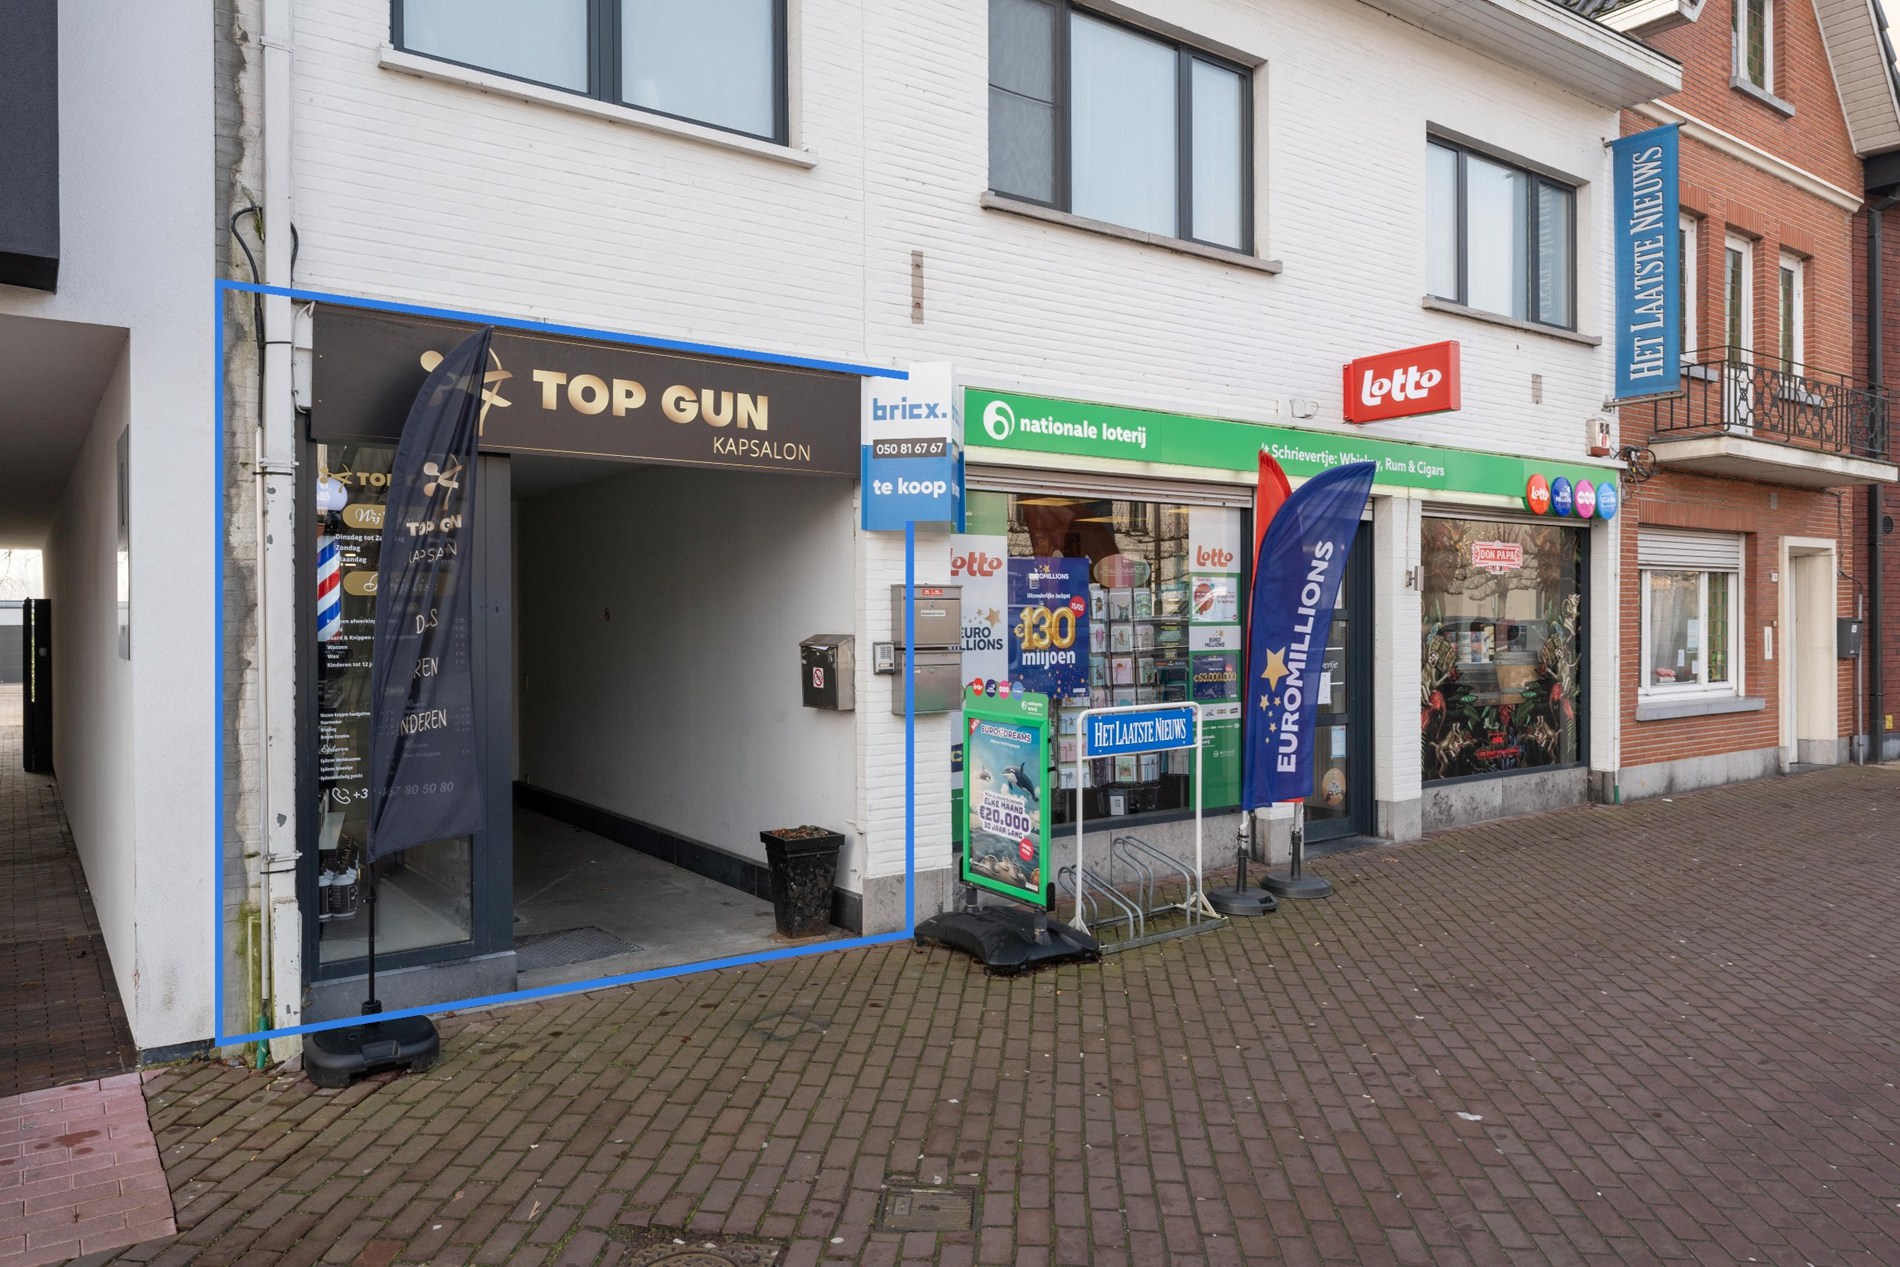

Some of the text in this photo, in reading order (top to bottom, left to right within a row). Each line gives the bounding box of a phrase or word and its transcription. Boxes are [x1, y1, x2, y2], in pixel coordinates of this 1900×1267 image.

[1630, 146, 1664, 381] HET LAATSTE NIEUWS
[532, 369, 769, 432] TOP GUN
[1361, 365, 1442, 407] Lotto
[1020, 416, 1147, 449] nationale loterij
[713, 436, 811, 462] KAPSALON
[876, 444, 898, 455] 050
[900, 444, 913, 454] 81
[914, 443, 928, 454] 67
[930, 442, 944, 454] 67
[1271, 444, 1338, 467] Schrievertje:
[1385, 458, 1406, 472] Rum
[1408, 460, 1416, 472] &
[1417, 461, 1445, 479] Cigars
[872, 479, 893, 495] te
[897, 477, 947, 498] koop
[1480, 550, 1515, 560] DON PAPA
[1022, 651, 1076, 670] miljoen
[1276, 540, 1334, 773] EUROMILLIONS
[1094, 722, 1115, 747] HET
[1115, 721, 1155, 745] LAATSTE
[1155, 717, 1187, 741] NIEUWS
[979, 804, 1030, 833] €20.000
[984, 797, 1000, 808] ELKE
[1000, 802, 1024, 815] MAAND
